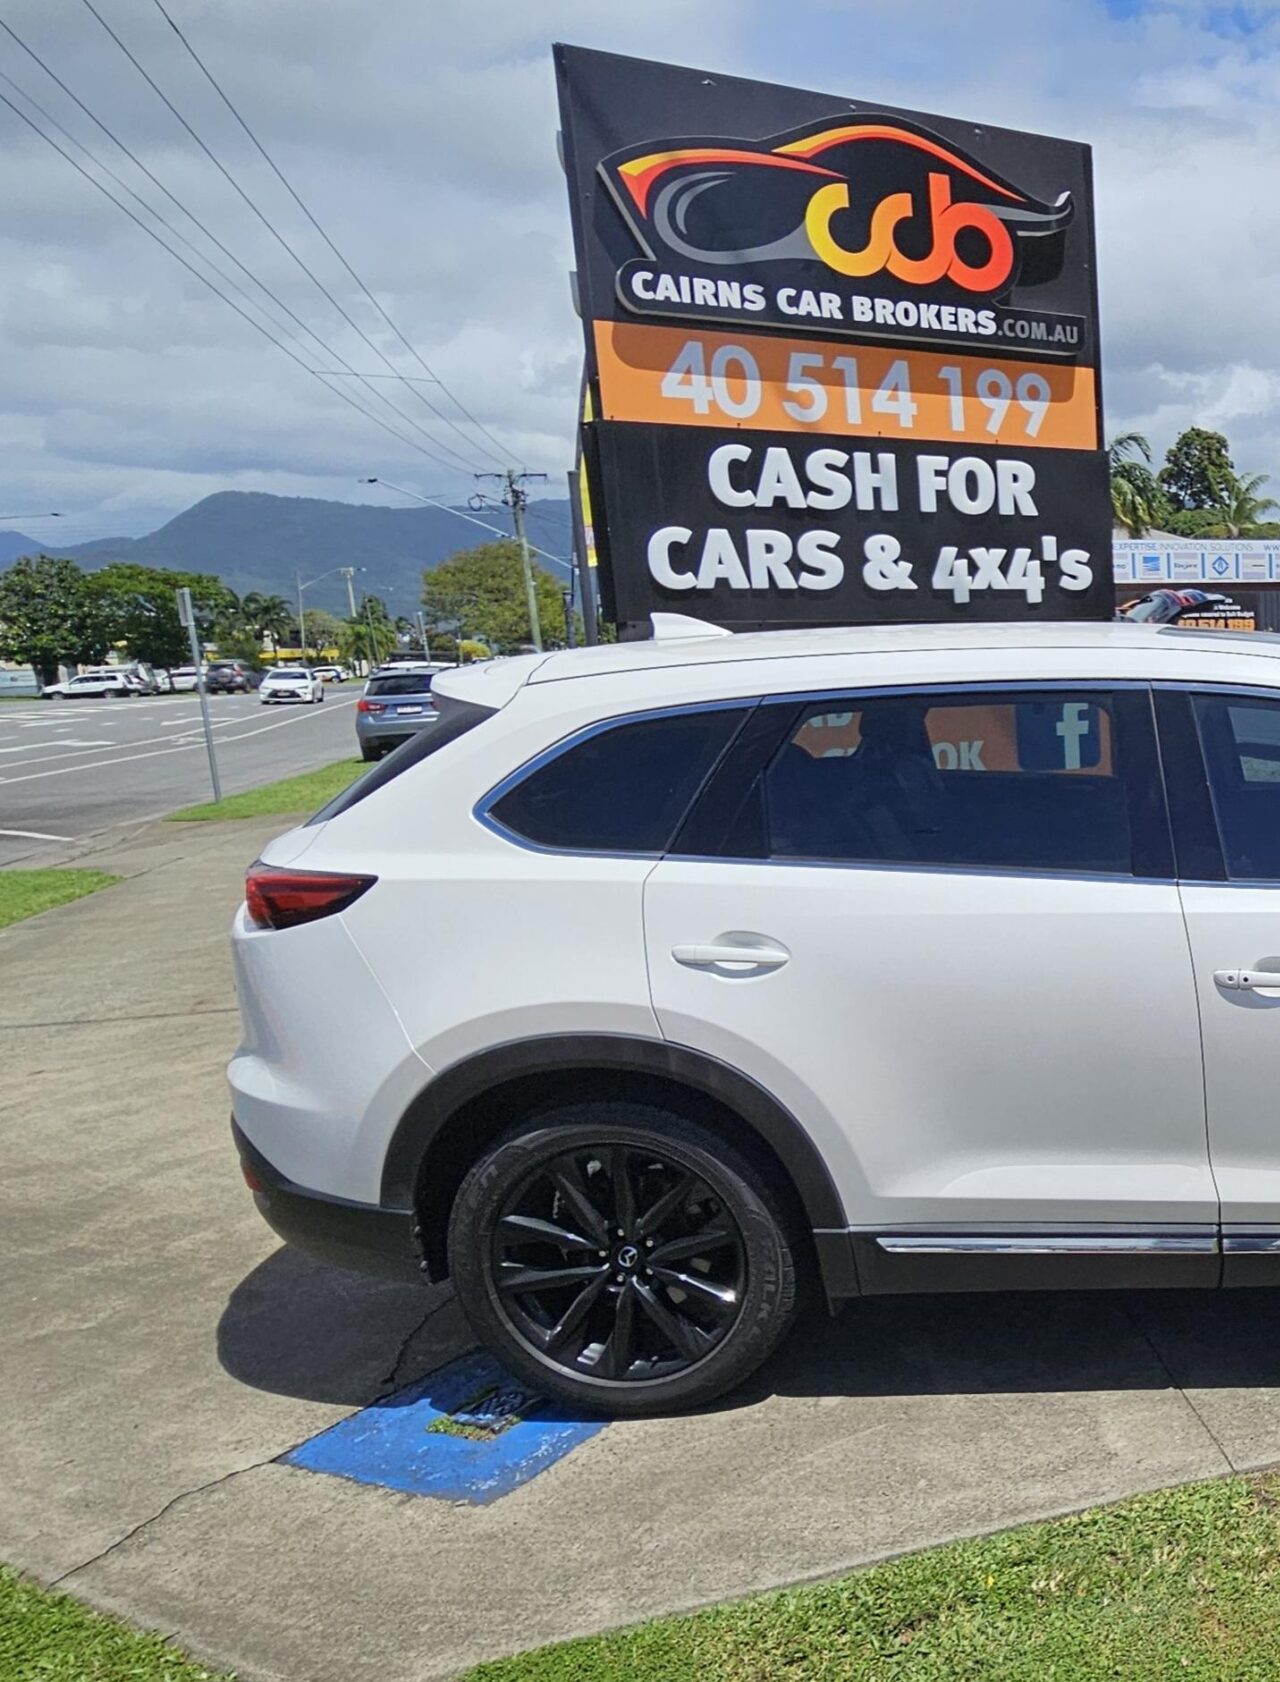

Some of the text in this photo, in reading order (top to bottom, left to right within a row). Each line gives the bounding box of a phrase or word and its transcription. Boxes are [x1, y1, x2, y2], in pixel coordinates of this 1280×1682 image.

[631, 271, 767, 311] CAIRNS
[776, 288, 844, 320] CAR
[660, 340, 1052, 438] 40 514 199
[708, 444, 1039, 517] CASH FOR
[647, 526, 845, 590] CARS
[862, 534, 918, 590] &
